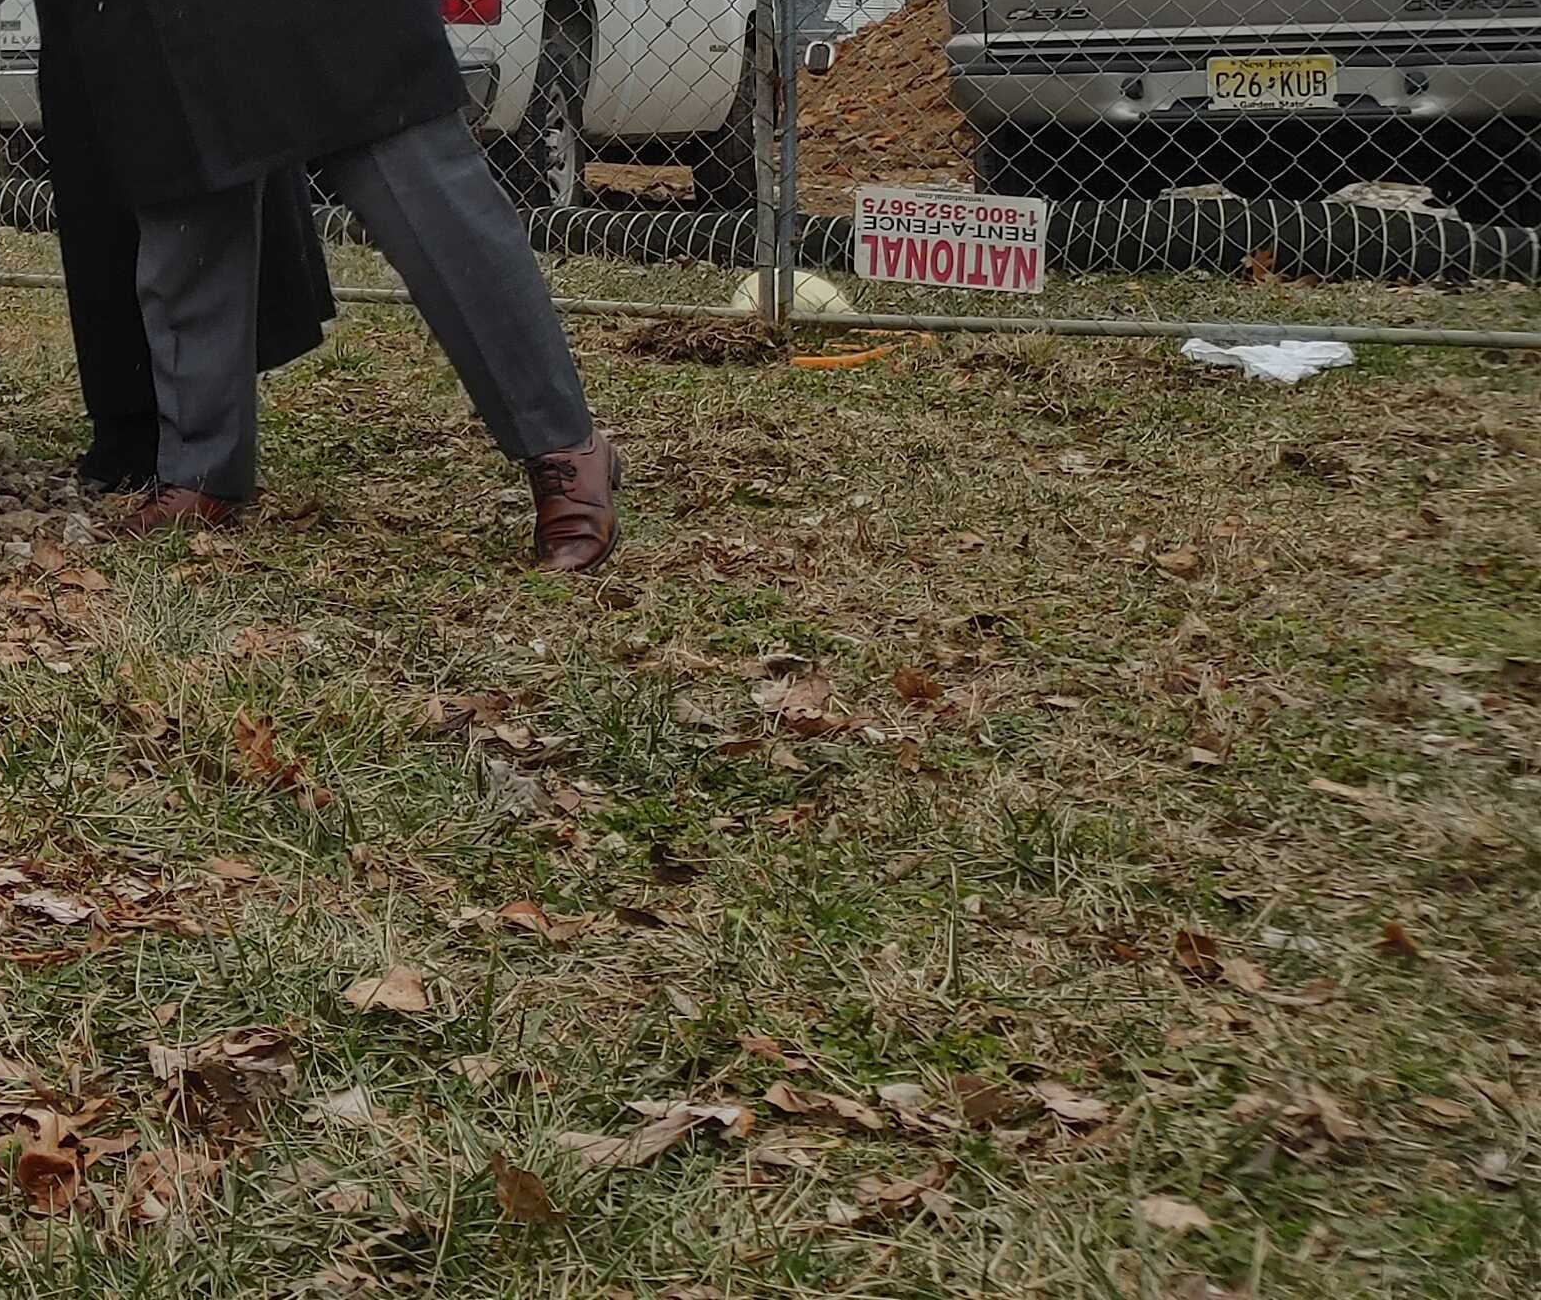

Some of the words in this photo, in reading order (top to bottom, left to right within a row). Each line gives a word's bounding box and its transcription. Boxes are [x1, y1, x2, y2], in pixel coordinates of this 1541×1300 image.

[1216, 72, 1263, 98] C26
[1279, 70, 1327, 97] KUB
[862, 198, 1038, 226] 1-800-352-5675
[863, 215, 1037, 243] RENT-A-FENCE
[861, 234, 1038, 290] NATIONAL
